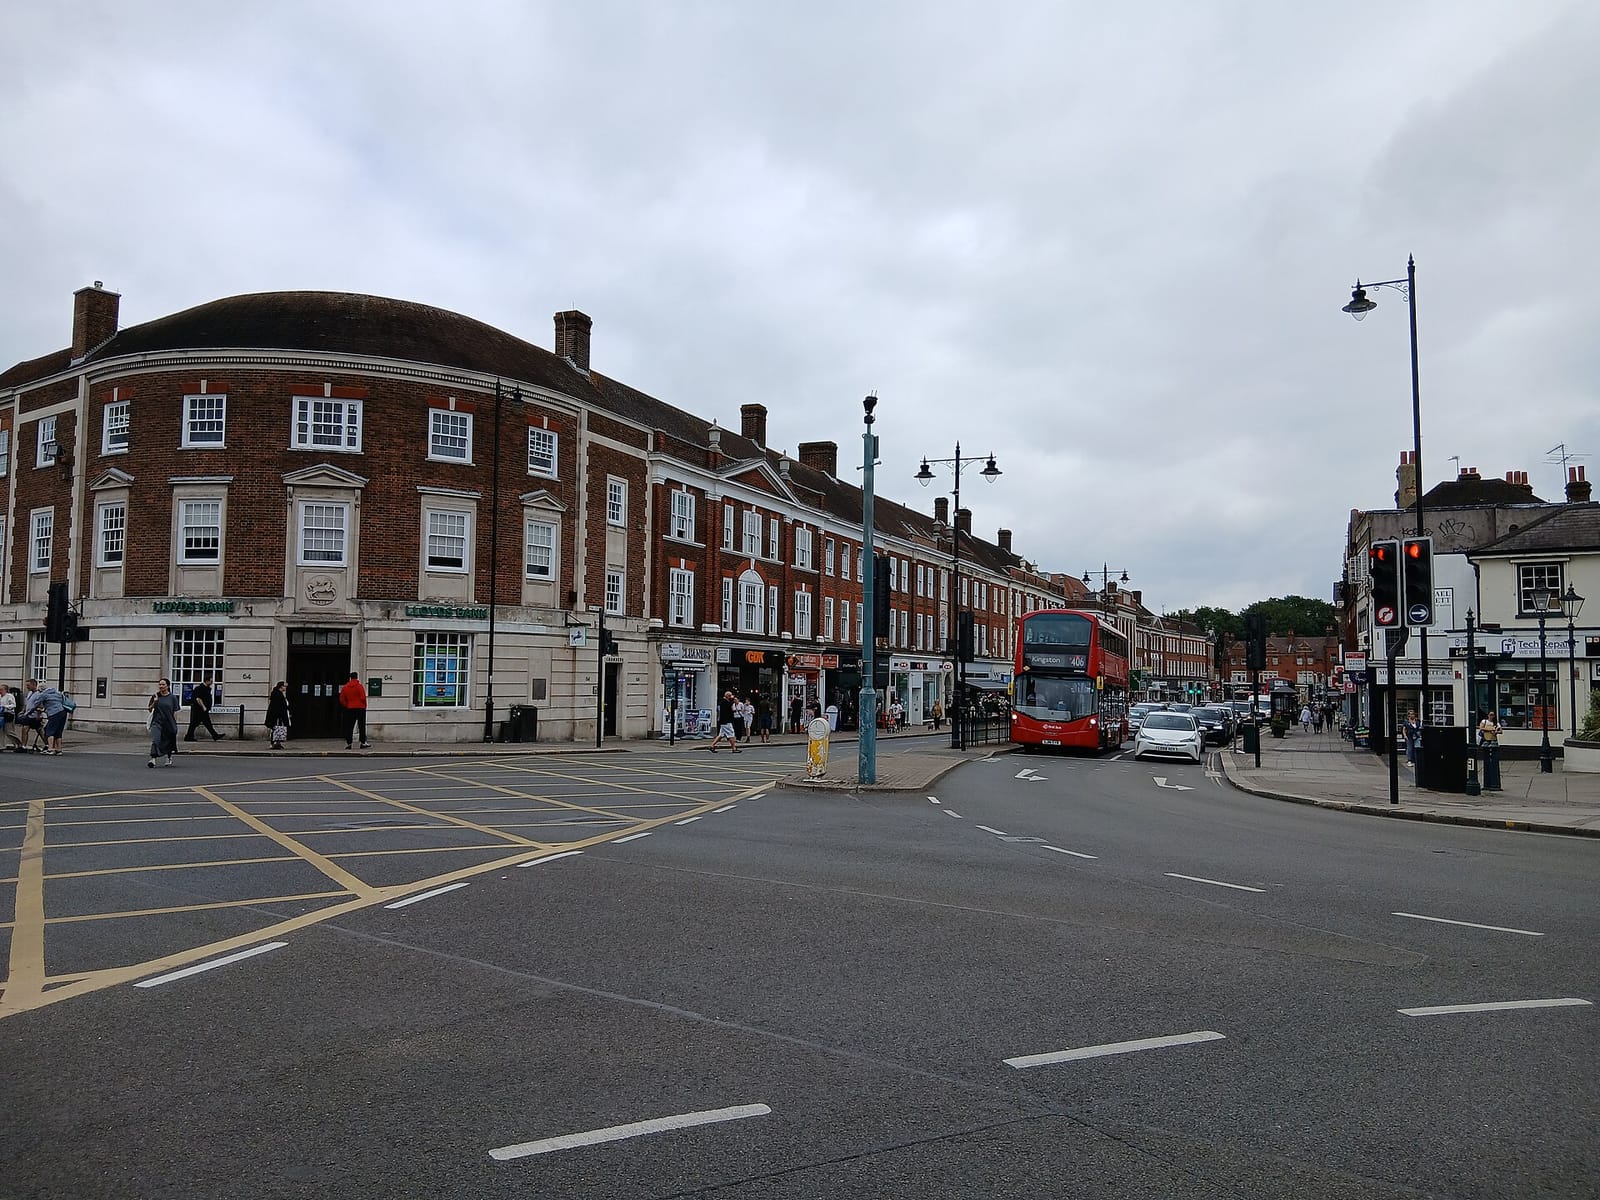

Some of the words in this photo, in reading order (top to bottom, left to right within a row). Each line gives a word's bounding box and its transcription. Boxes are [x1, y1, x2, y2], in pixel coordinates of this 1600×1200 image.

[152, 602, 195, 613] LLOYDS
[199, 602, 234, 613] BANK
[406, 606, 453, 617] LLOYDS
[456, 608, 488, 618] BANK
[1518, 640, 1539, 649] Tech
[1032, 655, 1061, 664] Kingston
[1071, 656, 1085, 667] 406
